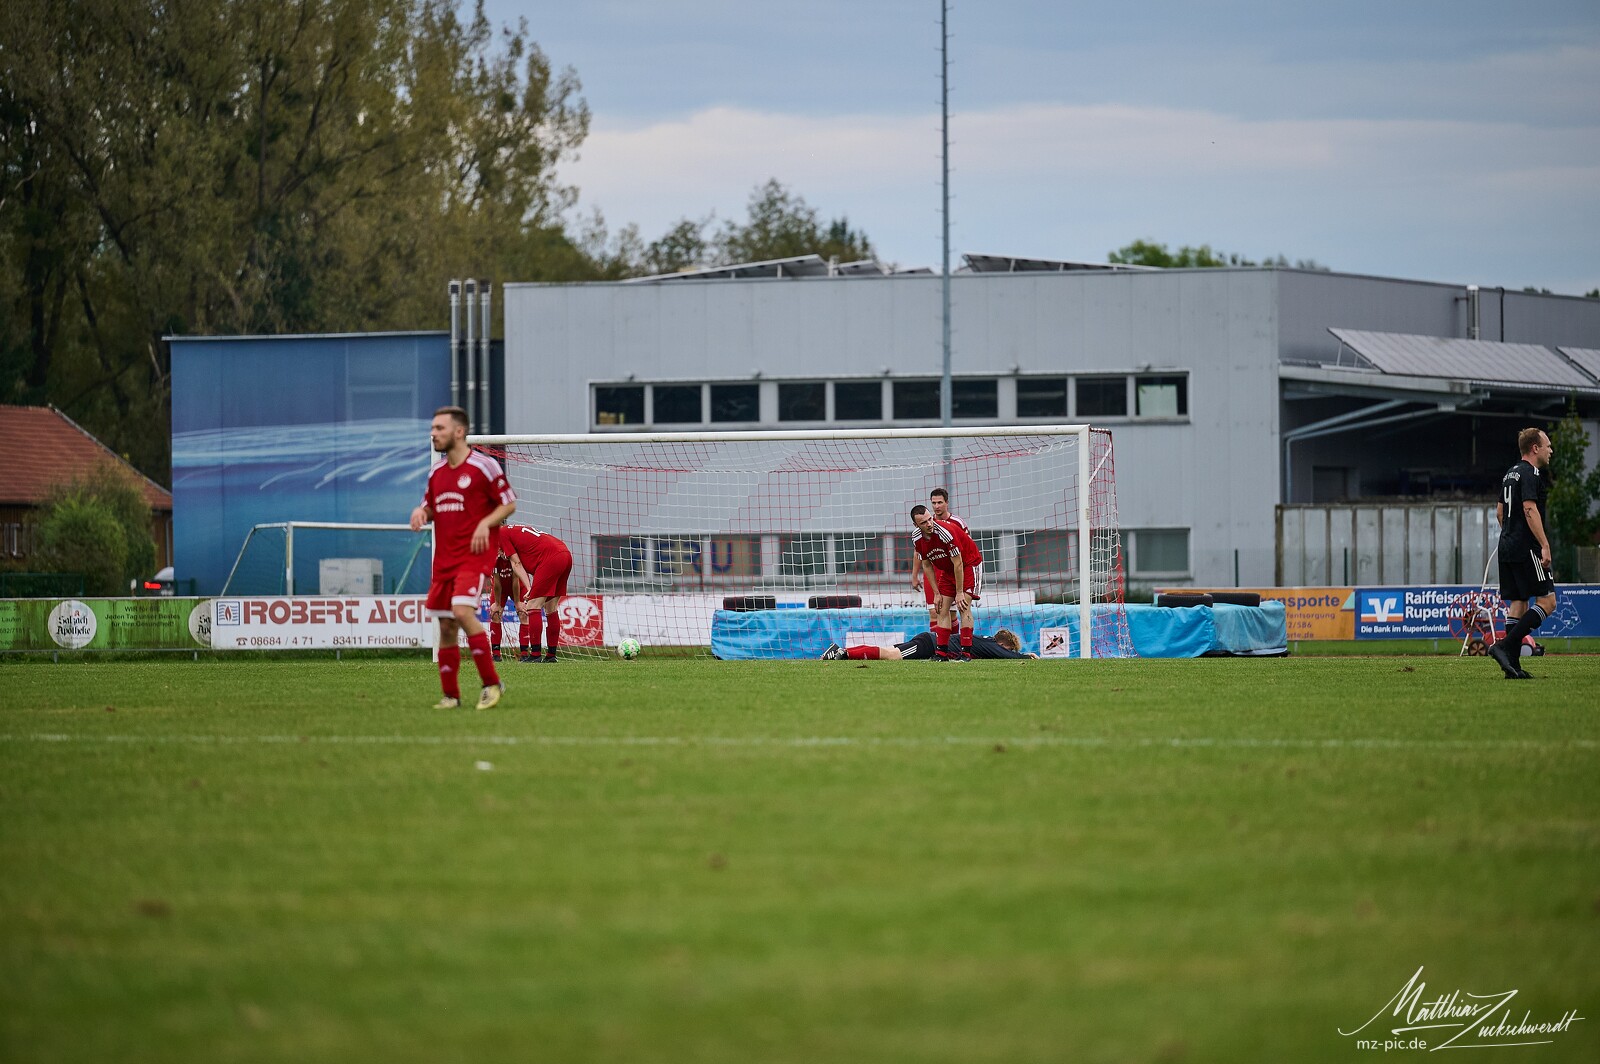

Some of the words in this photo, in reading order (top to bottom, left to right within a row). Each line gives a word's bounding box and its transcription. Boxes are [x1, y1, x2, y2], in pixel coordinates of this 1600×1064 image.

[1504, 485, 1512, 518] 4
[243, 600, 360, 624] ROBERT
[1288, 621, 1312, 629] 2/586
[1361, 625, 1372, 633] Die
[1374, 625, 1391, 633] Bank
[1392, 625, 1401, 633] im
[1402, 624, 1450, 634] Rupertiwinkel
[250, 636, 281, 646] 08684
[302, 636, 314, 646] 71
[332, 635, 363, 646] 83411
[367, 635, 418, 647] Fridolfing
